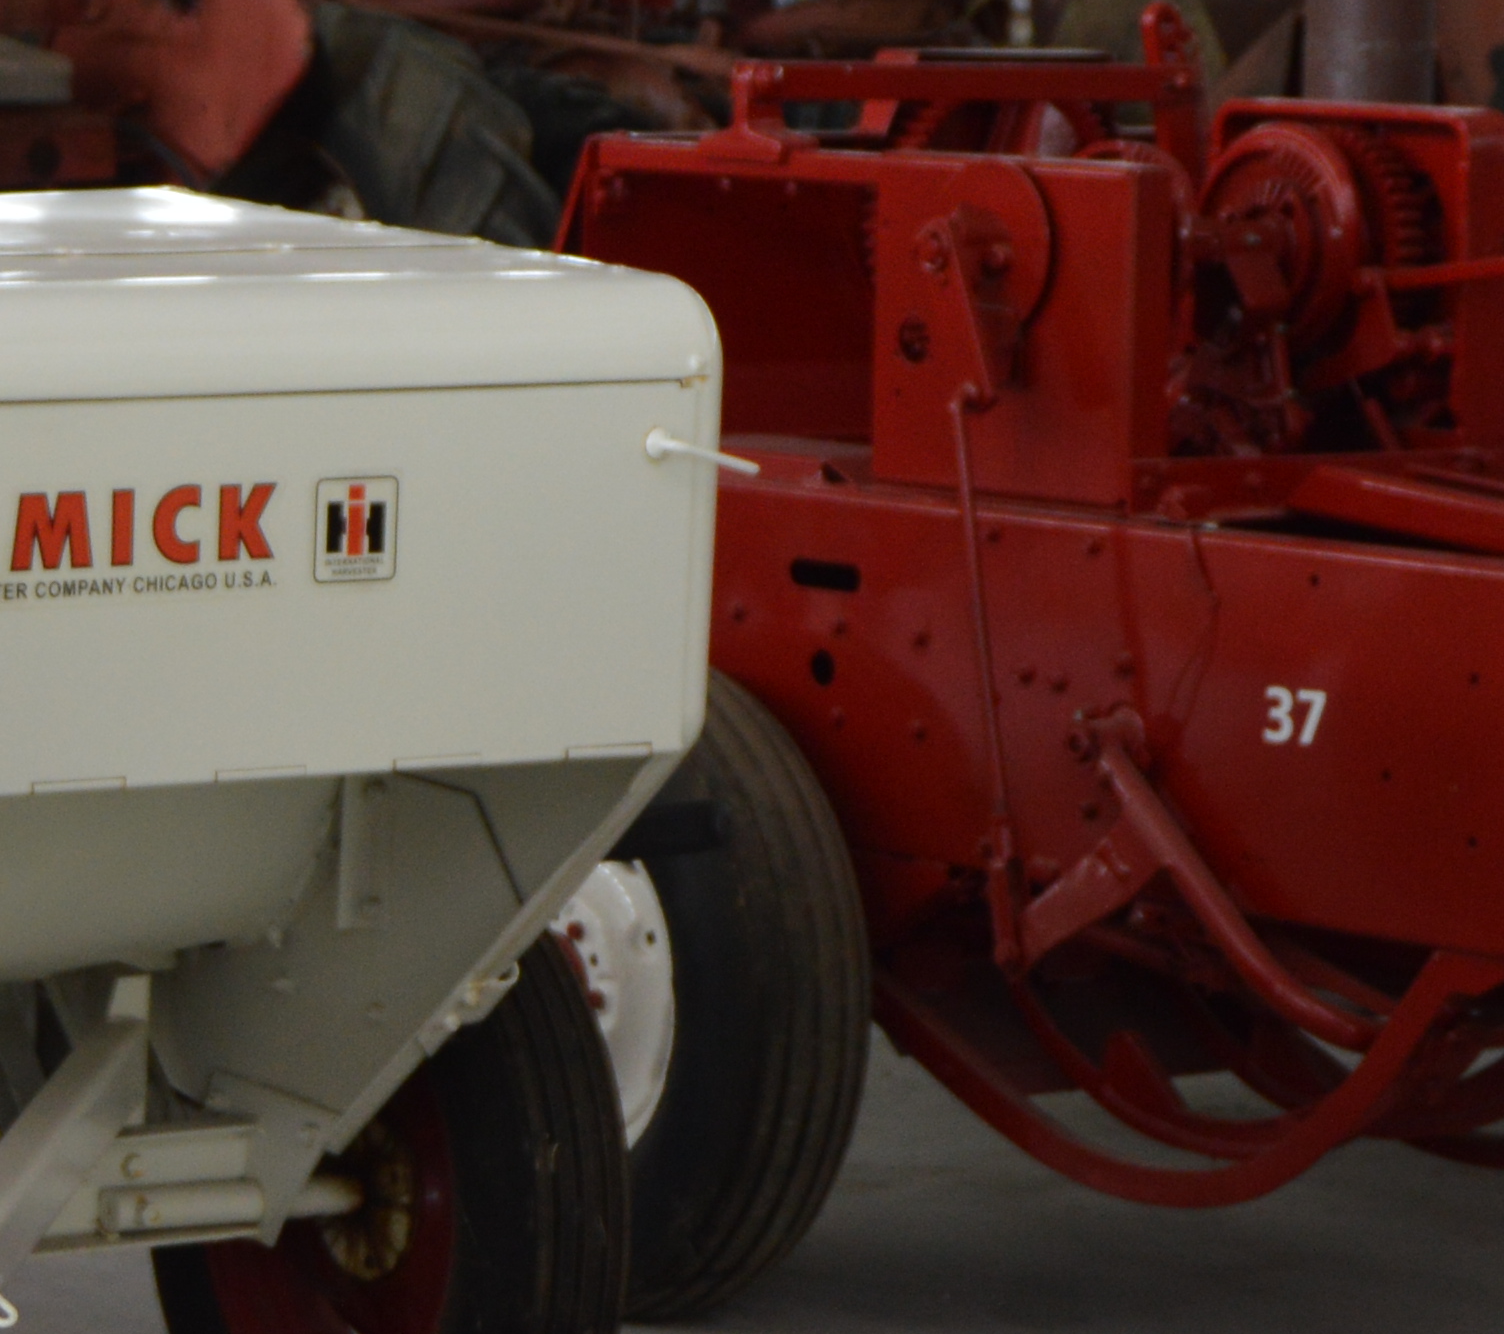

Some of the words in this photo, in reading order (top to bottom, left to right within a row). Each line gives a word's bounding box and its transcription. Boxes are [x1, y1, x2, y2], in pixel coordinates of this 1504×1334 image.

[34, 576, 127, 600] COMPANY
[132, 570, 218, 593] CHICAGO
[223, 569, 278, 590] U.S.A.
[1262, 685, 1328, 746] 37
